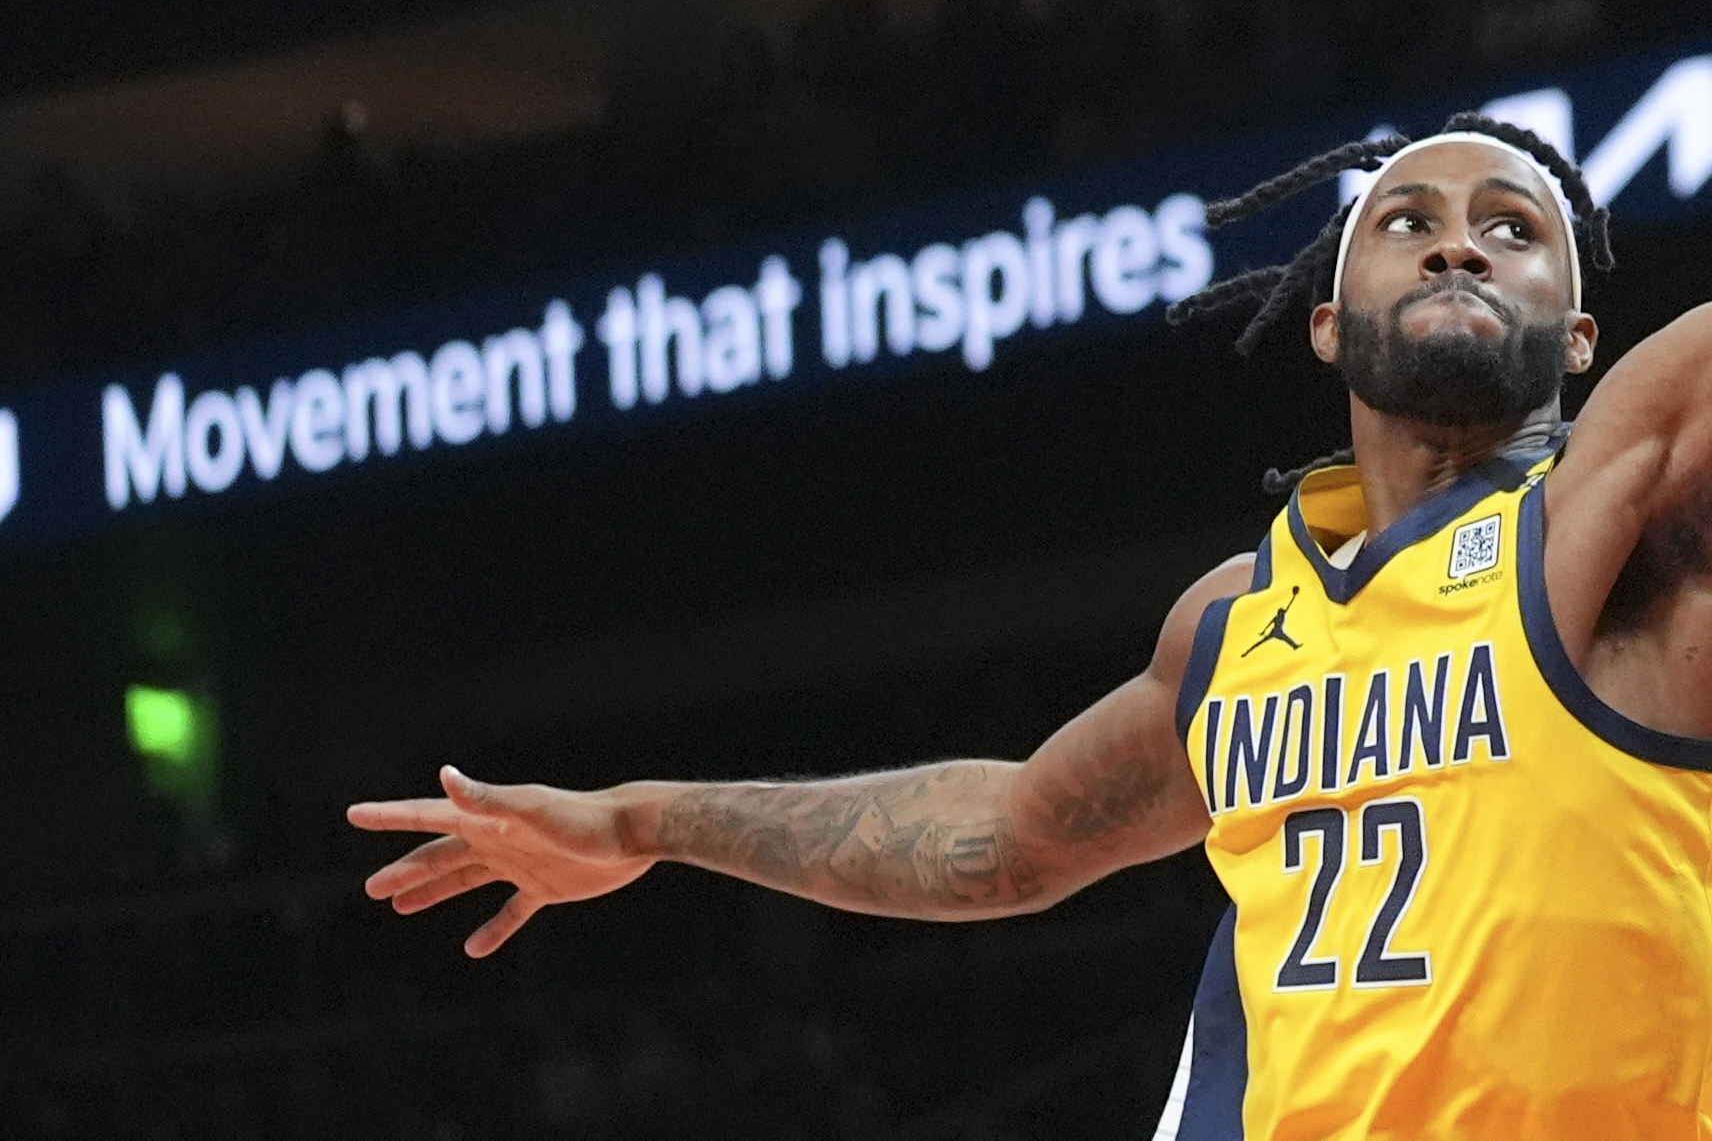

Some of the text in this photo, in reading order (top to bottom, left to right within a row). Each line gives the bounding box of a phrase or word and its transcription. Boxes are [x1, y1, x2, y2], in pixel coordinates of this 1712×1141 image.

[102, 299, 586, 511] Movement
[596, 255, 803, 411] that
[818, 192, 1216, 371] inspires
[1438, 570, 1504, 598] spokenote
[1204, 641, 1511, 818] INDIANA
[1272, 796, 1432, 993] 22
